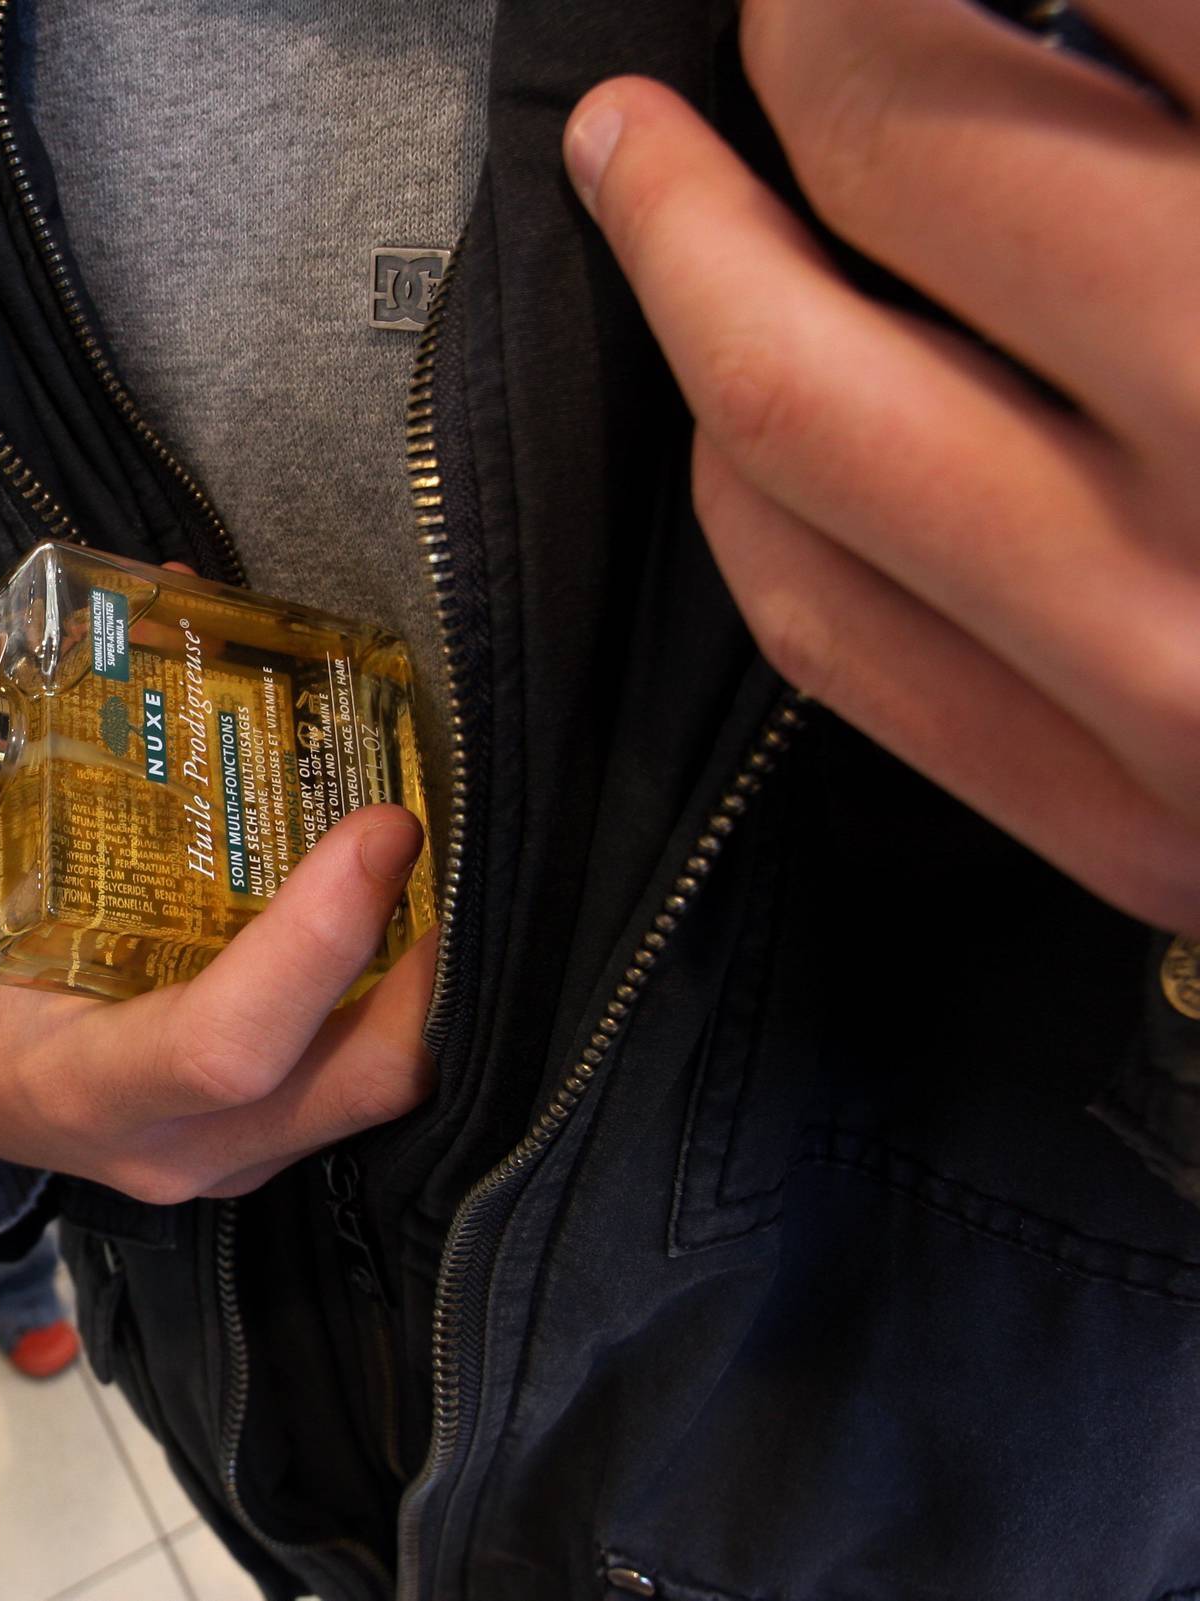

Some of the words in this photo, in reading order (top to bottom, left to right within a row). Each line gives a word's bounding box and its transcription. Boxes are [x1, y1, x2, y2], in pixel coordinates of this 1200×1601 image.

[92, 590, 102, 636] SURACTIVÉE
[105, 602, 116, 667] SUPER-ACTIVATED
[94, 636, 103, 671] FORMULE
[116, 619, 125, 655] FORMULA
[263, 666, 273, 674] E
[334, 658, 347, 686] HAIR
[263, 676, 277, 729] VITAMINE
[336, 688, 351, 722] BODY,
[145, 692, 165, 777] NUXE
[268, 732, 278, 747] ET
[319, 703, 334, 749] VITAMIN
[341, 724, 355, 754] FACE,
[238, 706, 256, 803] MULTI-USAGES
[252, 727, 266, 783] ADOUCIT
[283, 750, 297, 786] CARE
[298, 757, 311, 779] OIL
[308, 726, 322, 777] SOFTENS
[324, 752, 337, 779] AND
[220, 714, 242, 846] MULTI-FONCTIONS
[269, 749, 284, 816] PRÉCIEUSES
[300, 781, 314, 811] DRY
[327, 781, 339, 807] OILS
[345, 766, 360, 812] HEVEUX
[257, 787, 272, 836] RÉPARE,
[313, 781, 328, 832] REPAIRS,
[183, 794, 215, 881] Huile
[245, 807, 260, 851] SÈCHE
[275, 819, 289, 862] HUILES
[303, 813, 318, 851] SAGE
[89, 879, 149, 899] TRGLYCERIDE,
[230, 850, 245, 888] SOIN
[248, 854, 263, 897] HUILE
[261, 841, 277, 898] NOURRIT,
[279, 864, 289, 872] 6
